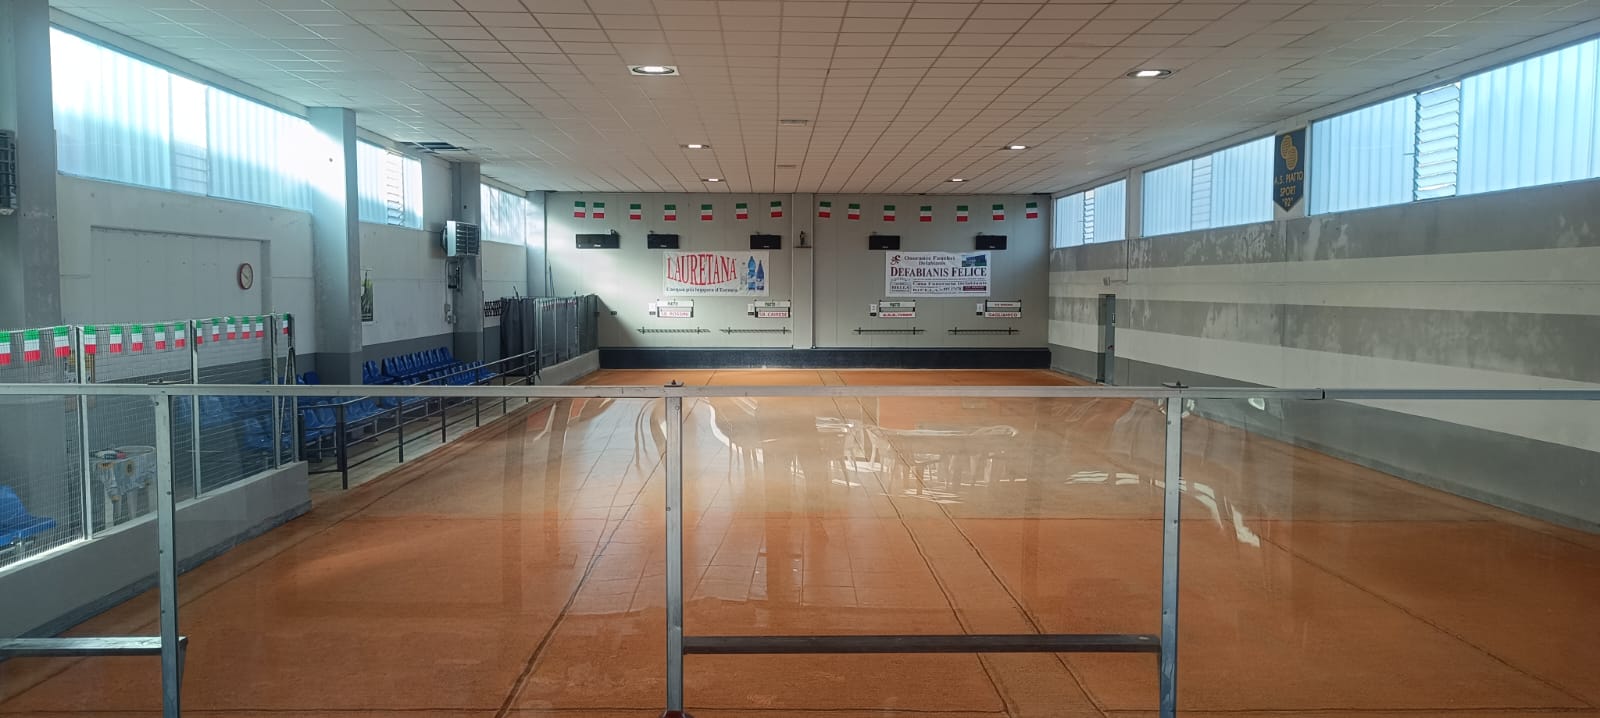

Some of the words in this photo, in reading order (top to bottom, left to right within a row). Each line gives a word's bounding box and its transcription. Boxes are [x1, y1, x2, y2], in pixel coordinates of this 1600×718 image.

[1285, 170, 1304, 182] PIATTO
[1280, 185, 1297, 197] SPORT
[667, 253, 737, 286] LAURETANA
[890, 266, 949, 277] DEFABIANIS
[951, 266, 987, 277] FELICE
